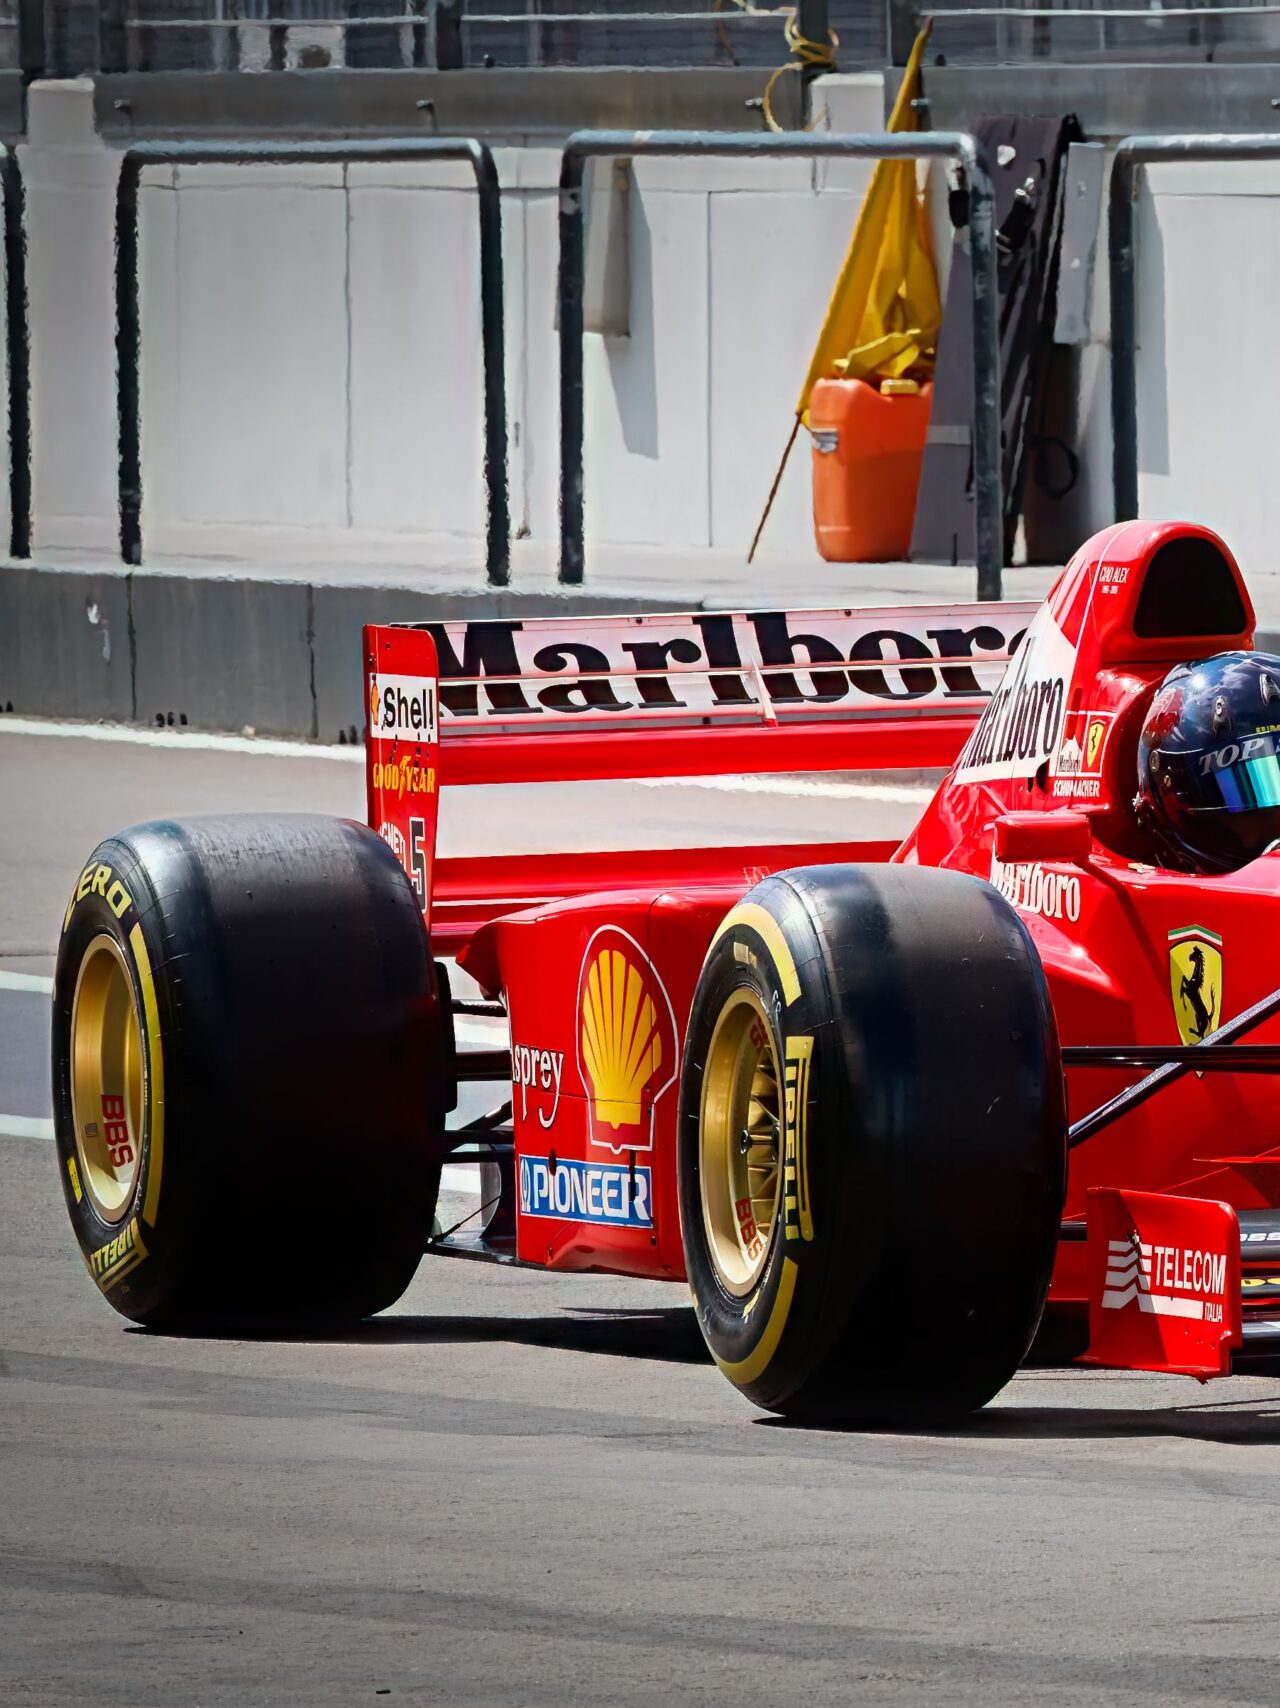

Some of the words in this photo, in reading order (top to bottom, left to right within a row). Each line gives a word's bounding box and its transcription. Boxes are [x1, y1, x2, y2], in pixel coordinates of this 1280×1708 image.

[391, 611, 1029, 717] Marlbor
[383, 687, 433, 729] Shell
[1199, 737, 1265, 776] TOP
[409, 817, 427, 914] 5
[512, 1044, 564, 1128] sprey
[101, 1094, 134, 1167] BBS
[784, 1036, 815, 1241] PIRELLI
[533, 1163, 651, 1220] PIONEER
[734, 1199, 767, 1262] BBS
[1154, 1246, 1227, 1295] TELECOM
[1204, 1302, 1223, 1323] ITALIA
